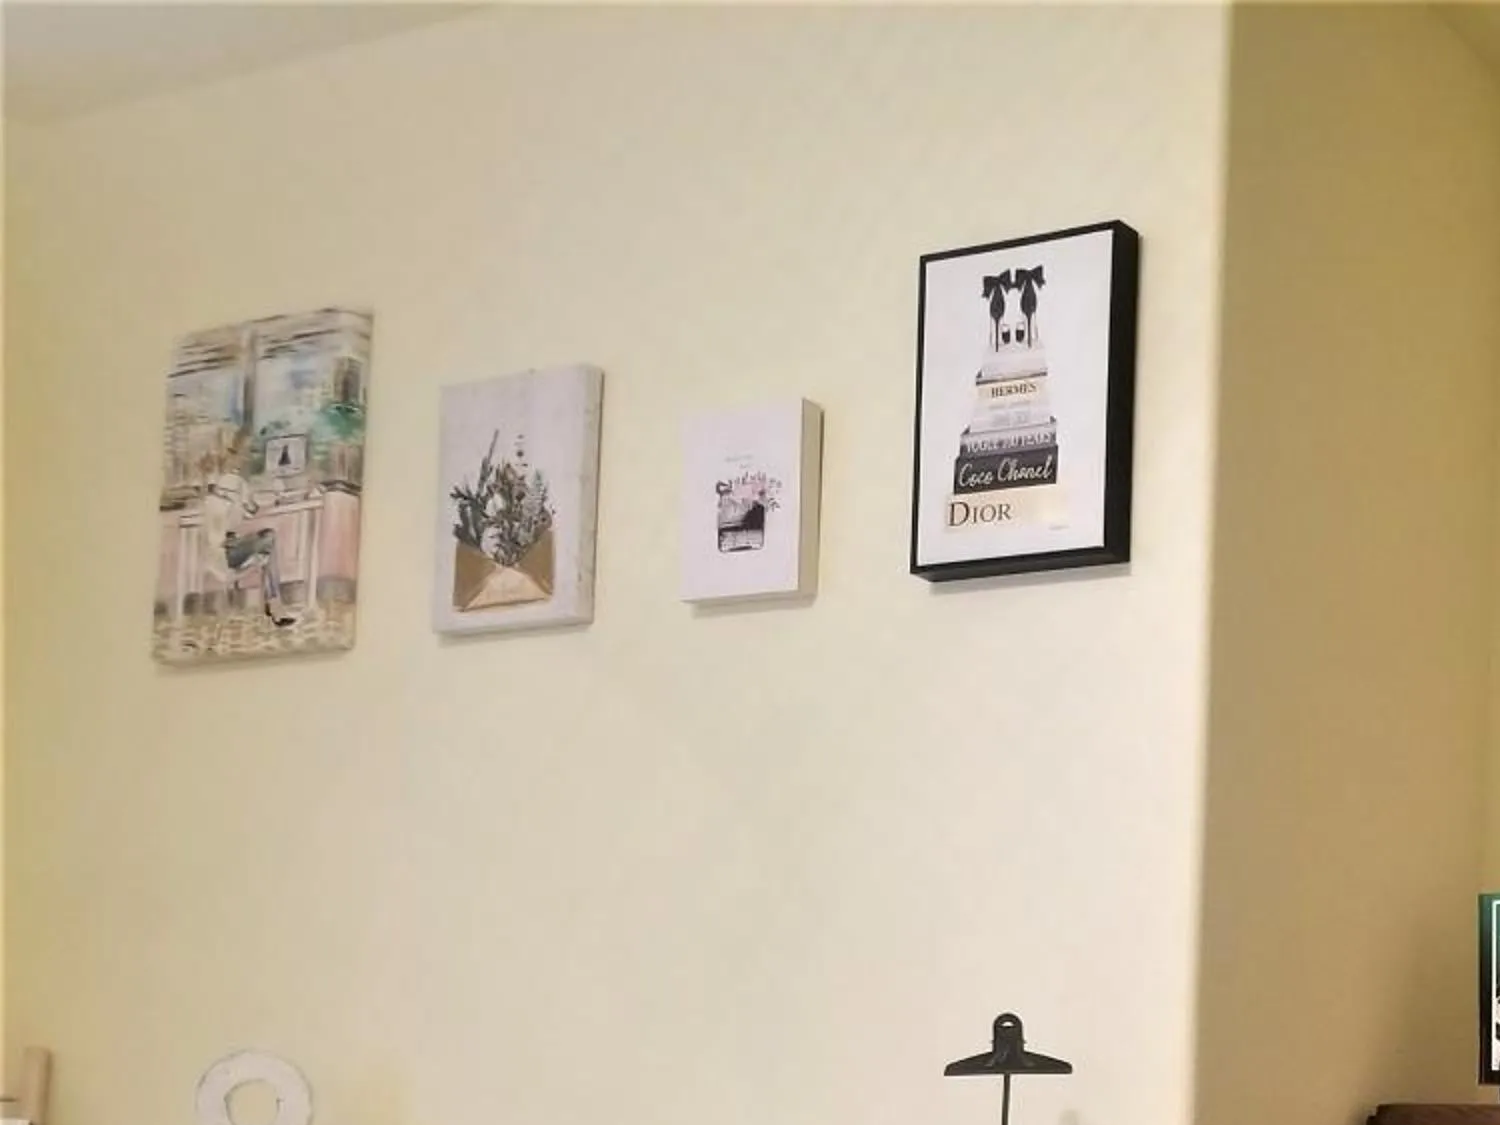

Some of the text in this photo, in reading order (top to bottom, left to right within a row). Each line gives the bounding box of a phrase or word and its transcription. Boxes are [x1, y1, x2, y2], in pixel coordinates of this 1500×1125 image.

[959, 455, 1053, 487] Coco Chanel
[948, 501, 1013, 527] DIOR
